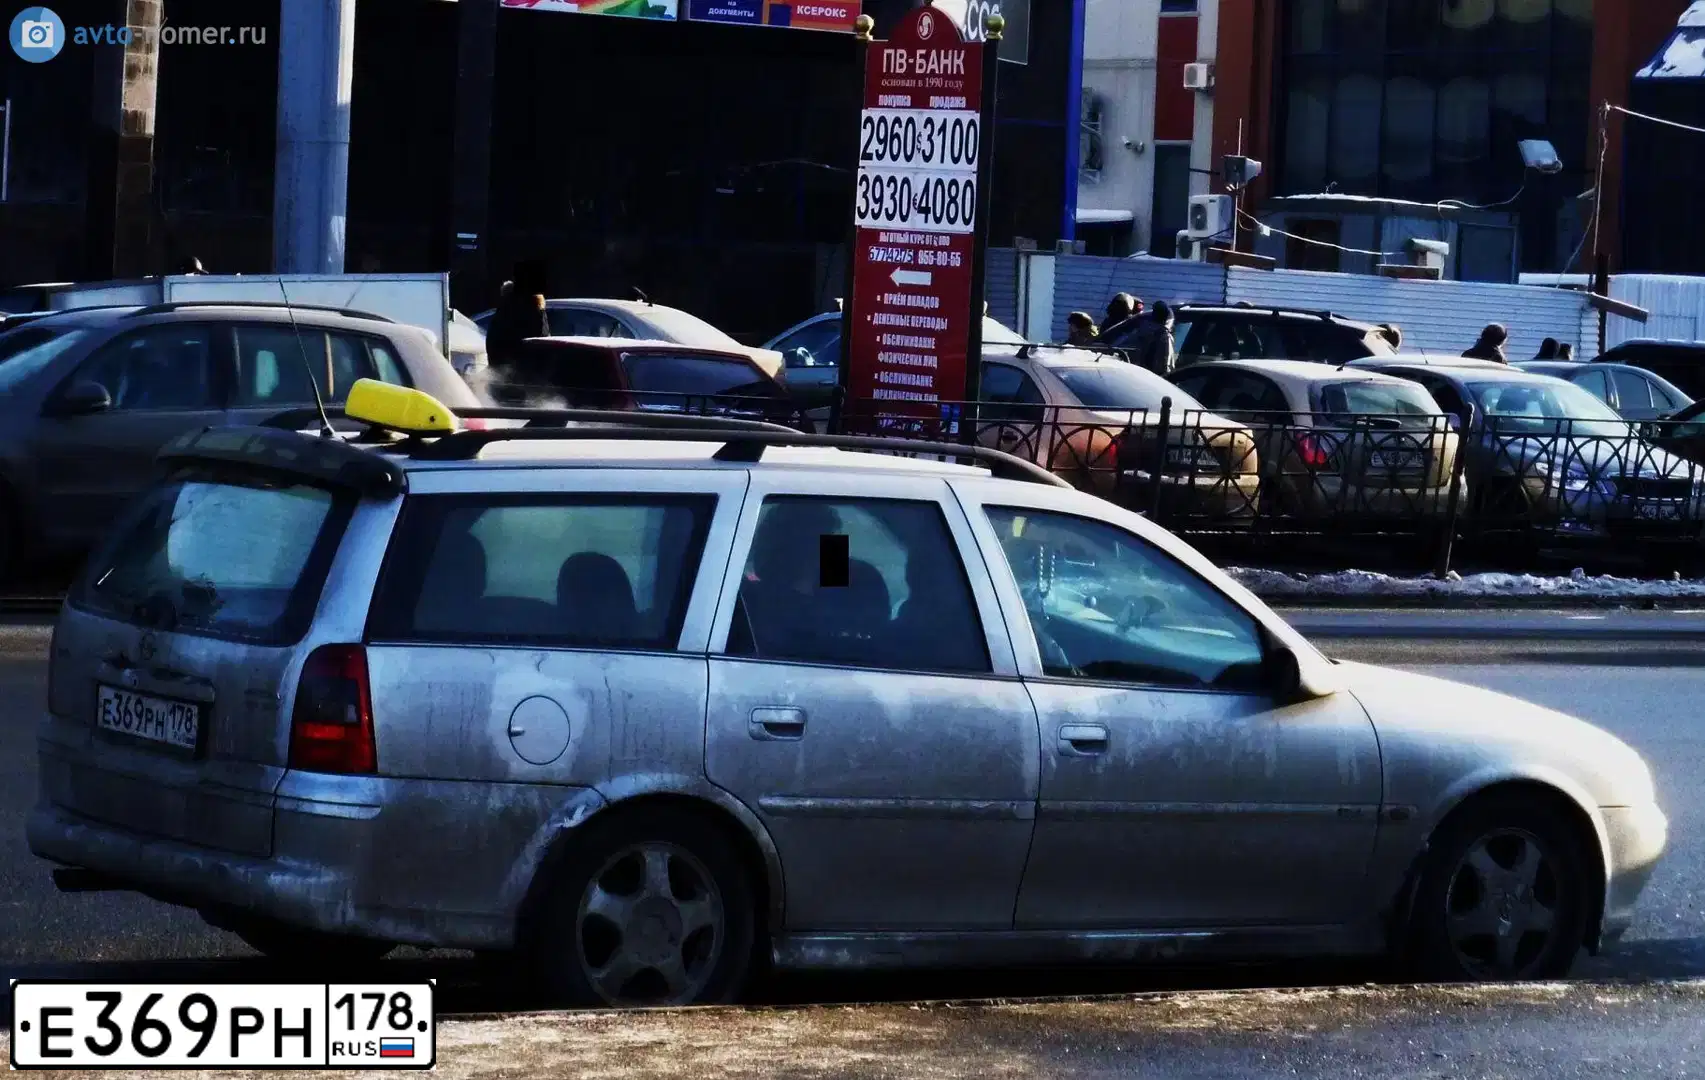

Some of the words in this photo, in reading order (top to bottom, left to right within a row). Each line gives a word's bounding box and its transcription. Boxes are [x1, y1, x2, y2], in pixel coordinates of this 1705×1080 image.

[708, 7, 754, 17] ДОКУМЕНТЫ
[797, 5, 847, 18] КСЕРОКС
[883, 48, 965, 75] ПВ-БАНК
[881, 79, 916, 87] основан
[925, 78, 943, 88] 1990
[944, 79, 964, 91] году
[878, 94, 911, 107] покупка
[929, 95, 967, 109] продажа
[860, 115, 917, 162] 2960
[921, 116, 978, 165] 3100
[857, 174, 912, 222] 3930
[917, 177, 975, 226] 4080
[883, 292, 907, 305] ПРИЁМ
[907, 295, 940, 309] ВКЛАДОВ
[872, 312, 910, 326] ДЕНЕЖНЫЕ
[910, 315, 948, 330] ПЕРЕВОДЫ
[882, 333, 936, 349] ОБСЛУЖИВАНИЕ
[877, 351, 922, 366] ФИЗИЧЕСКИХ
[922, 356, 938, 370] ЛИЦ
[880, 371, 933, 387] ОБСЛУЖИВАНИЕ
[169, 703, 194, 734] 178
